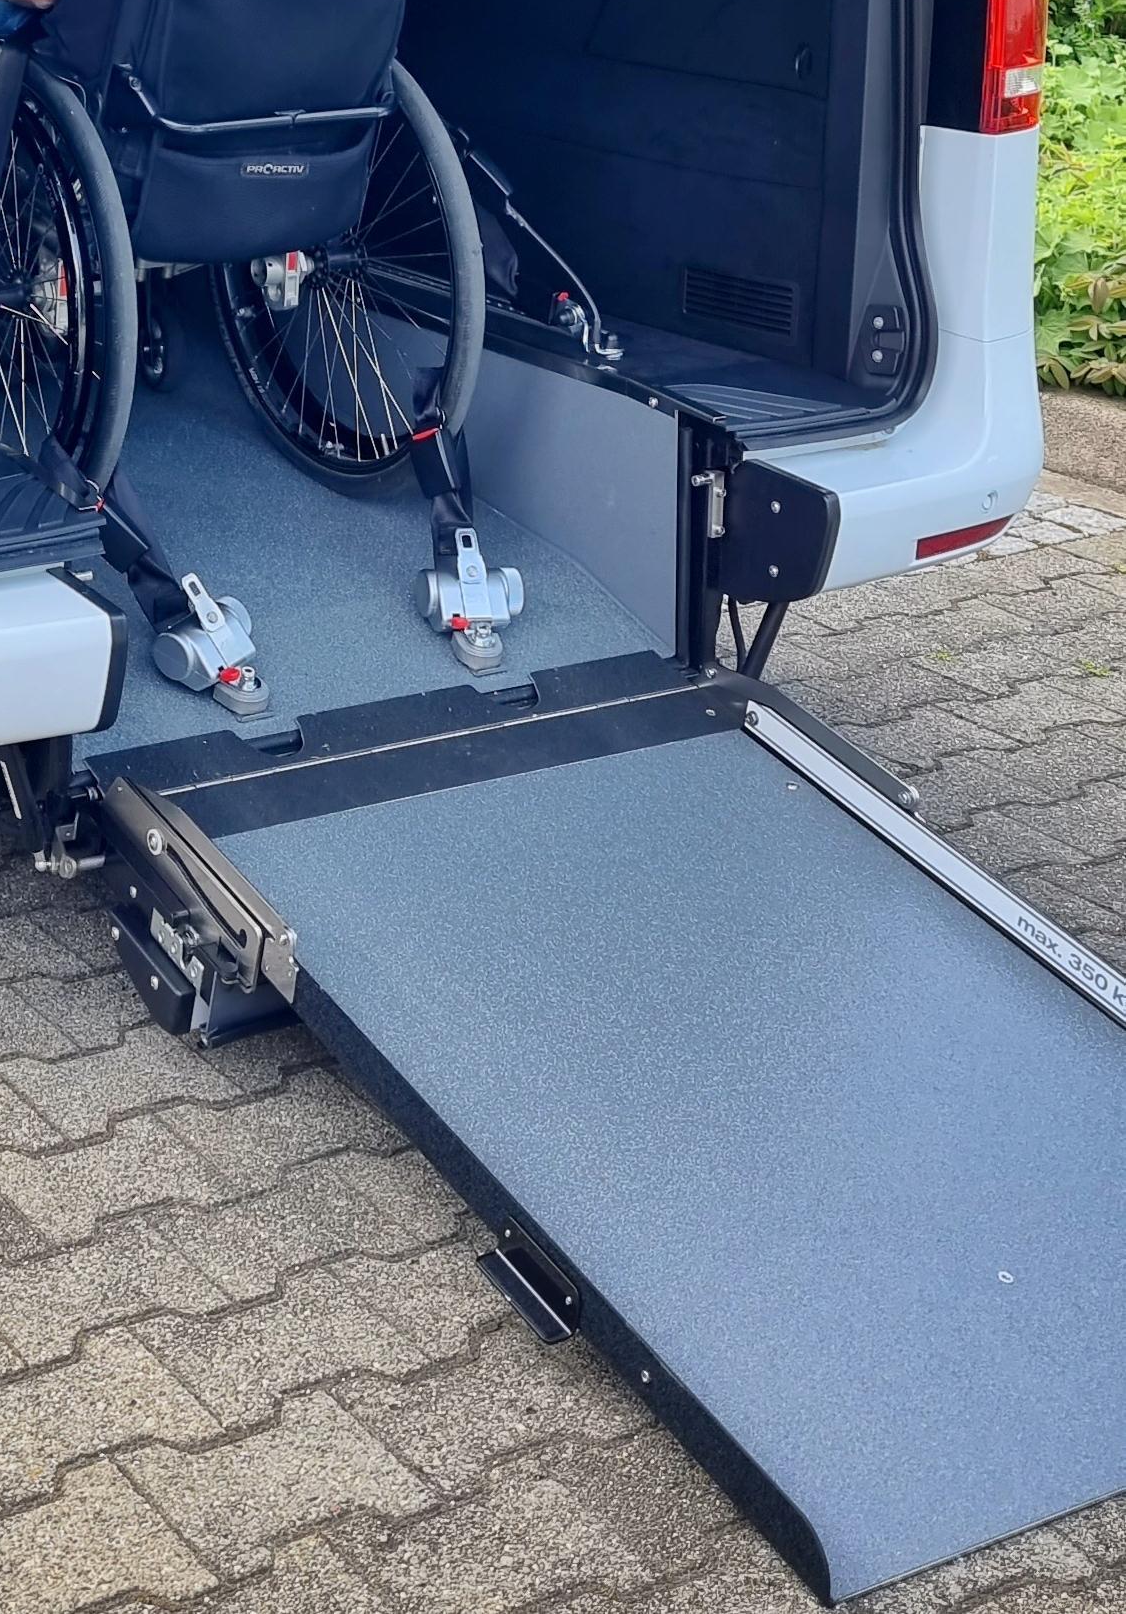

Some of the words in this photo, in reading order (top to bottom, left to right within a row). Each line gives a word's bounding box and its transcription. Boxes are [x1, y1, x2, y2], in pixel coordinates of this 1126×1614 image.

[246, 163, 305, 175] PROACTIV
[1017, 916, 1062, 959] max.
[1068, 953, 1108, 991] 350
[1112, 985, 1126, 1012] k
